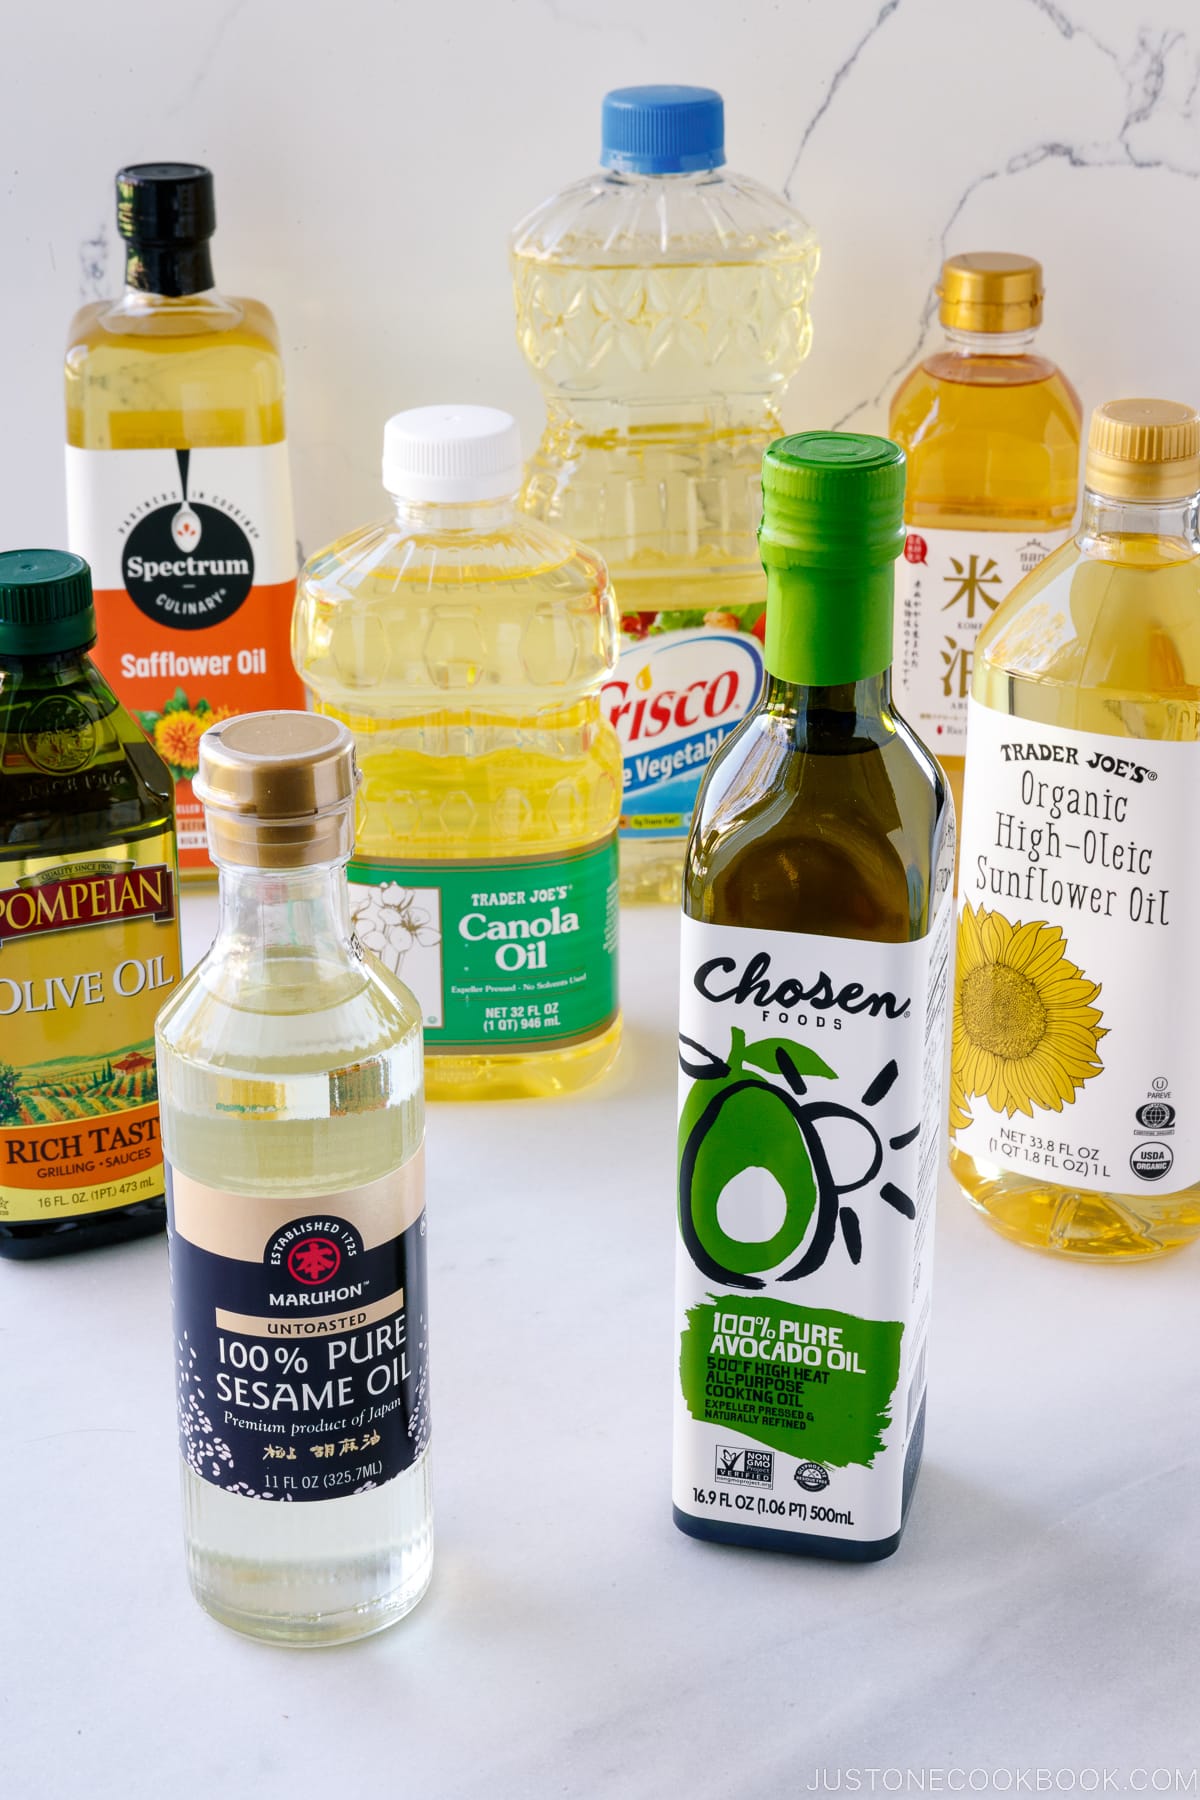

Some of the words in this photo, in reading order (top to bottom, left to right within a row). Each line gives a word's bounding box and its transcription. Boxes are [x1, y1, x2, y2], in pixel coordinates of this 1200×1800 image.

[127, 556, 249, 582] Spectrum
[121, 649, 231, 678] Safflower
[237, 648, 266, 674] Oil
[636, 727, 732, 783] Vegetabl
[1001, 743, 1079, 765] TRADER
[1022, 770, 1128, 823] Organic
[994, 811, 1152, 875] High-Oleic
[41, 866, 73, 880] QUALITY
[74, 863, 96, 873] SINCE
[0, 871, 163, 930] OMPEIAN
[471, 891, 526, 907] TRADER
[976, 855, 1117, 917] Sunflower
[1129, 886, 1169, 926] Oil
[458, 906, 580, 942] Canola
[495, 941, 548, 971] Oil
[0, 971, 104, 1016] OLIVE
[113, 955, 174, 997] OIL
[451, 985, 483, 995] Expeller
[485, 984, 516, 993] Pressed
[569, 972, 587, 985] Used
[483, 1019, 495, 1033] (1
[498, 1018, 519, 1032] QT)
[520, 1017, 542, 1029] 946
[544, 1015, 561, 1027] mL
[485, 1006, 508, 1019] NET
[510, 1005, 526, 1017] 32
[527, 1004, 541, 1016] FL
[544, 1002, 559, 1015] OZ
[762, 1011, 842, 1030] FOODS
[1147, 1091, 1172, 1099] PAREVE
[5, 1134, 82, 1165] RICH
[88, 1116, 161, 1154] TAST
[1000, 1128, 1025, 1142] NET
[1030, 1136, 1055, 1151] 33.8
[1059, 1143, 1073, 1156] FL
[1078, 1147, 1100, 1161] OZ
[37, 1161, 95, 1179] GRILLING
[105, 1147, 151, 1168] SAUCES
[989, 1137, 998, 1153] (1
[1001, 1143, 1019, 1157] QT
[1024, 1149, 1040, 1163] 1.8
[1044, 1154, 1059, 1168] FL
[1063, 1158, 1089, 1176] OZ)
[1093, 1164, 1098, 1176] 1
[1102, 1165, 1111, 1177] L
[1136, 1161, 1168, 1170] ORGANIC
[1140, 1151, 1165, 1161] USDA
[38, 1198, 52, 1209] 16
[119, 1181, 138, 1194] 473
[140, 1176, 155, 1189] mL
[271, 1221, 340, 1265] ESTABLISHED
[341, 1231, 357, 1257] 1725
[267, 1312, 367, 1335] UNTOASTED
[713, 1312, 776, 1339] 100%
[779, 1320, 843, 1349] PURE
[328, 1314, 407, 1370] PURE
[709, 1334, 823, 1367] AVOCADO
[827, 1350, 866, 1374] OIL
[216, 1373, 355, 1412] SESAME
[367, 1352, 412, 1396] OIL
[706, 1370, 804, 1394] ALL-PURPOSE
[755, 1362, 790, 1379] HIGH
[793, 1368, 830, 1385] HEAT
[705, 1384, 772, 1404] COOKING
[776, 1392, 803, 1408] OIL
[705, 1399, 755, 1413] EXPELLER
[758, 1405, 804, 1421] PRESSED
[806, 1412, 815, 1422] &
[224, 1410, 286, 1433] Premium
[291, 1418, 347, 1437] product
[351, 1409, 367, 1428] of
[368, 1397, 401, 1423] Japan
[704, 1409, 759, 1424] NATURALLY
[762, 1416, 806, 1431] REFINED
[746, 1459, 770, 1468] GMO
[747, 1452, 770, 1461] NON
[264, 1474, 278, 1488] 11
[284, 1476, 297, 1489] FL
[302, 1475, 319, 1489] OZ
[323, 1460, 383, 1489] (325.7ML)
[720, 1469, 769, 1481] VERIFIED
[692, 1487, 717, 1505] 16.9
[719, 1493, 732, 1508] FL
[735, 1495, 754, 1511] OZ
[757, 1497, 786, 1516] (1.06
[789, 1502, 807, 1522] PT)
[810, 1506, 854, 1526] 500mL
